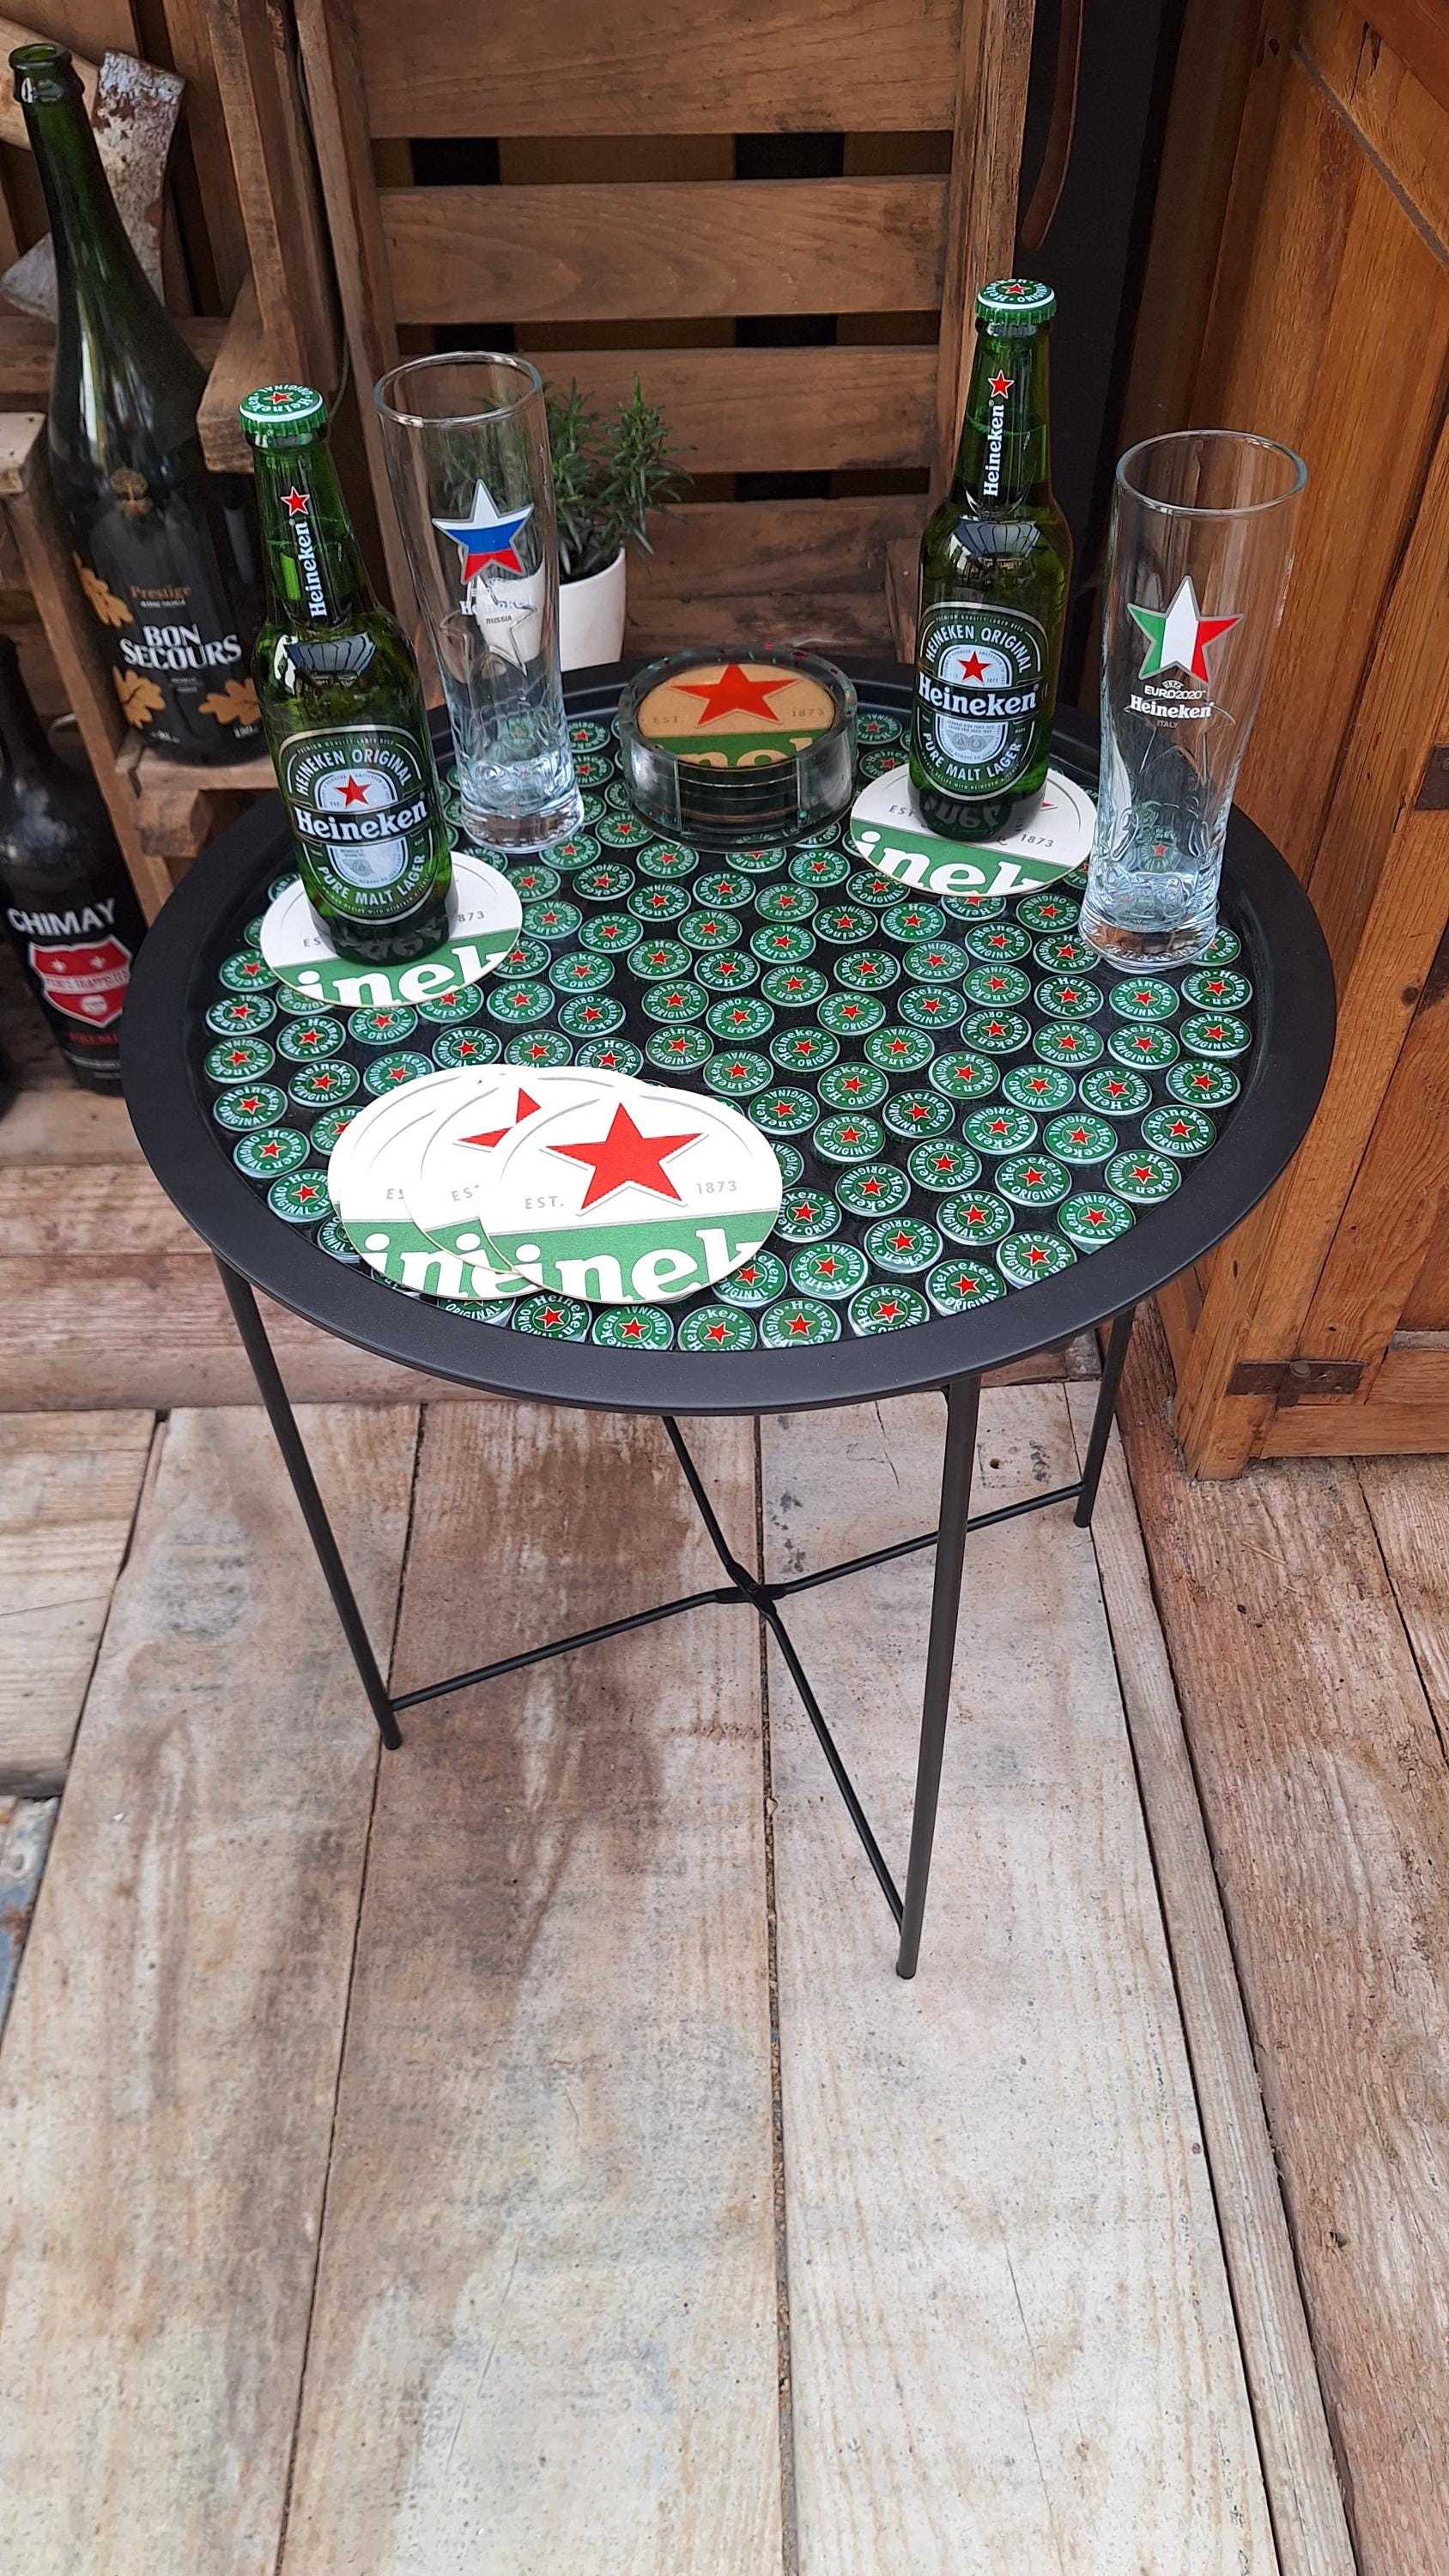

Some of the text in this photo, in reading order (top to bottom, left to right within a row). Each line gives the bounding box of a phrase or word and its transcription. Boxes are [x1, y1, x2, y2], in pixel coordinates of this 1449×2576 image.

[142, 623, 203, 647] BON
[486, 615, 512, 624] RUSSIA
[119, 635, 242, 671] SECOURS
[925, 625, 974, 663] HEINEKEN
[981, 628, 1032, 673] ORIGINAL
[791, 708, 825, 718] 1873
[295, 750, 346, 797] HEINEKEN
[352, 748, 412, 787] ORIGINAL
[923, 732, 944, 768] PURE
[946, 763, 981, 781] MALT
[986, 743, 1022, 778] LAGER
[1020, 833, 1054, 848] 1873
[318, 866, 350, 899] PURE
[355, 890, 394, 906] MALT
[396, 854, 426, 896] LAGER
[7, 898, 116, 936] CHIMAY
[458, 910, 485, 922] 873
[563, 996, 623, 1030] Heineken ORIGINAL
[712, 999, 771, 1033] Heineken ORIGINAL
[966, 1012, 1028, 1047] Heineken ORIGINAL
[1185, 1013, 1246, 1049] Heineken ORIGINAL
[282, 1018, 342, 1054] Heineken ORIGINAL
[437, 1029, 497, 1065] Heineken ORIGINAL
[649, 1027, 710, 1063] Heineken ORIGINAL
[773, 1029, 835, 1065] Heineken ORIGINAL
[867, 1029, 929, 1065] Heineken ORIGINAL
[1037, 1024, 1099, 1060] Heineken ORIGINAL
[1113, 1025, 1175, 1061] Heineken ORIGINAL
[208, 1040, 269, 1076] Heineken ORIGINAL
[706, 1053, 768, 1090] Heineken ORIGINAL
[935, 1054, 997, 1091] Heineken ORIGINAL
[292, 1063, 354, 1100] Heineken ORIGINAL
[819, 1066, 882, 1103] Heineken ORIGINAL
[1007, 1066, 1070, 1103] Heineken ORIGINAL
[1082, 1071, 1147, 1109] Heineken ORIGINAL
[1172, 1061, 1236, 1099] Heineken ORIGINAL
[218, 1084, 282, 1123] Heineken ORIGINAL
[752, 1090, 815, 1128] Heineken ORIGINAL
[887, 1091, 950, 1131] Heineken ORIGINAL
[817, 1115, 882, 1155] Heineken ORIGINAL
[968, 1107, 1034, 1147] Heineken ORIGINAL
[1047, 1115, 1113, 1156] Heineken ORIGINAL
[1146, 1109, 1212, 1149] Heineken ORIGINAL
[239, 1128, 305, 1168] Heineken ORIGINAL
[909, 1143, 976, 1185] Heineken ORIGINAL
[838, 1165, 905, 1208] Heineken ORIGINAL
[999, 1156, 1066, 1199] Heineken ORIGINAL
[1111, 1152, 1178, 1194] Heineken ORIGINAL
[524, 1180, 737, 1210] EST. 1873
[942, 1192, 1009, 1236] Heineken ORIGINAL
[1062, 1194, 1131, 1239] Heineken ORIGINAL
[870, 1218, 938, 1265] Heineken ORIGINAL
[1003, 1231, 1073, 1279] Heineken ORIGINAL
[791, 1244, 861, 1291] Heineken ORIGINAL
